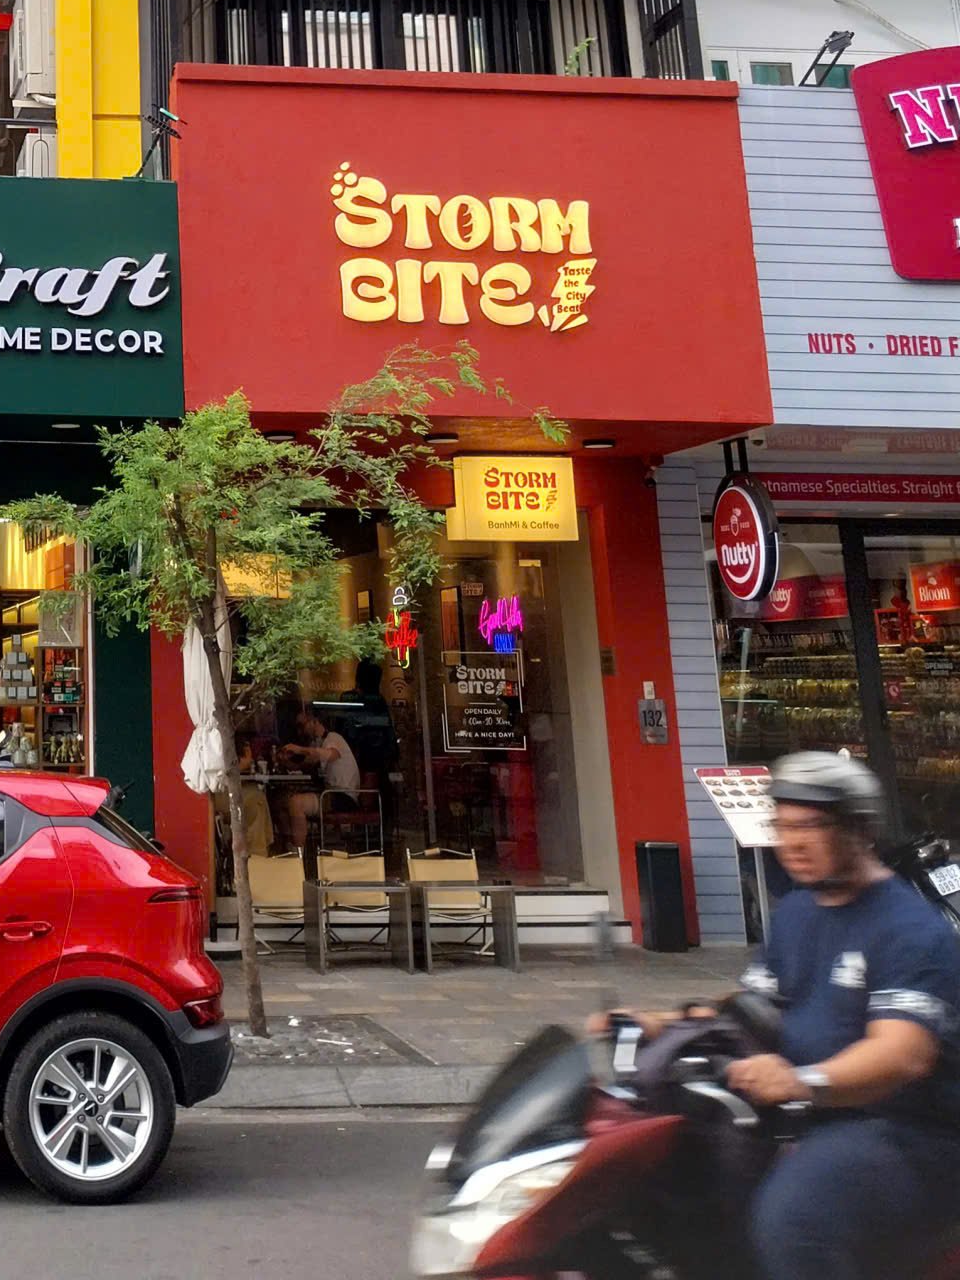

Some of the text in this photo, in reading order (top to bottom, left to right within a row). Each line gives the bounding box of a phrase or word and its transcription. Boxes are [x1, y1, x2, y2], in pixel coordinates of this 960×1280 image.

[889, 83, 960, 152] N
[331, 168, 592, 254] STORM
[563, 267, 592, 276] Taste
[339, 257, 535, 326] BITE
[564, 279, 579, 288] the
[566, 291, 587, 302] City
[557, 304, 580, 313] Beat
[51, 328, 165, 354] DECOR
[807, 333, 856, 354] NUTS
[886, 334, 942, 357] DRIED
[484, 466, 558, 489] STORM
[826, 480, 899, 496] Specialties.
[903, 481, 954, 498] Straight
[486, 491, 540, 510] BITE
[487, 520, 560, 530] BanhMi & Coffee
[721, 542, 756, 567] nutty
[919, 585, 950, 602] Bloom
[456, 665, 506, 680] STORM
[457, 681, 494, 694] BITE
[642, 711, 663, 727] 132
